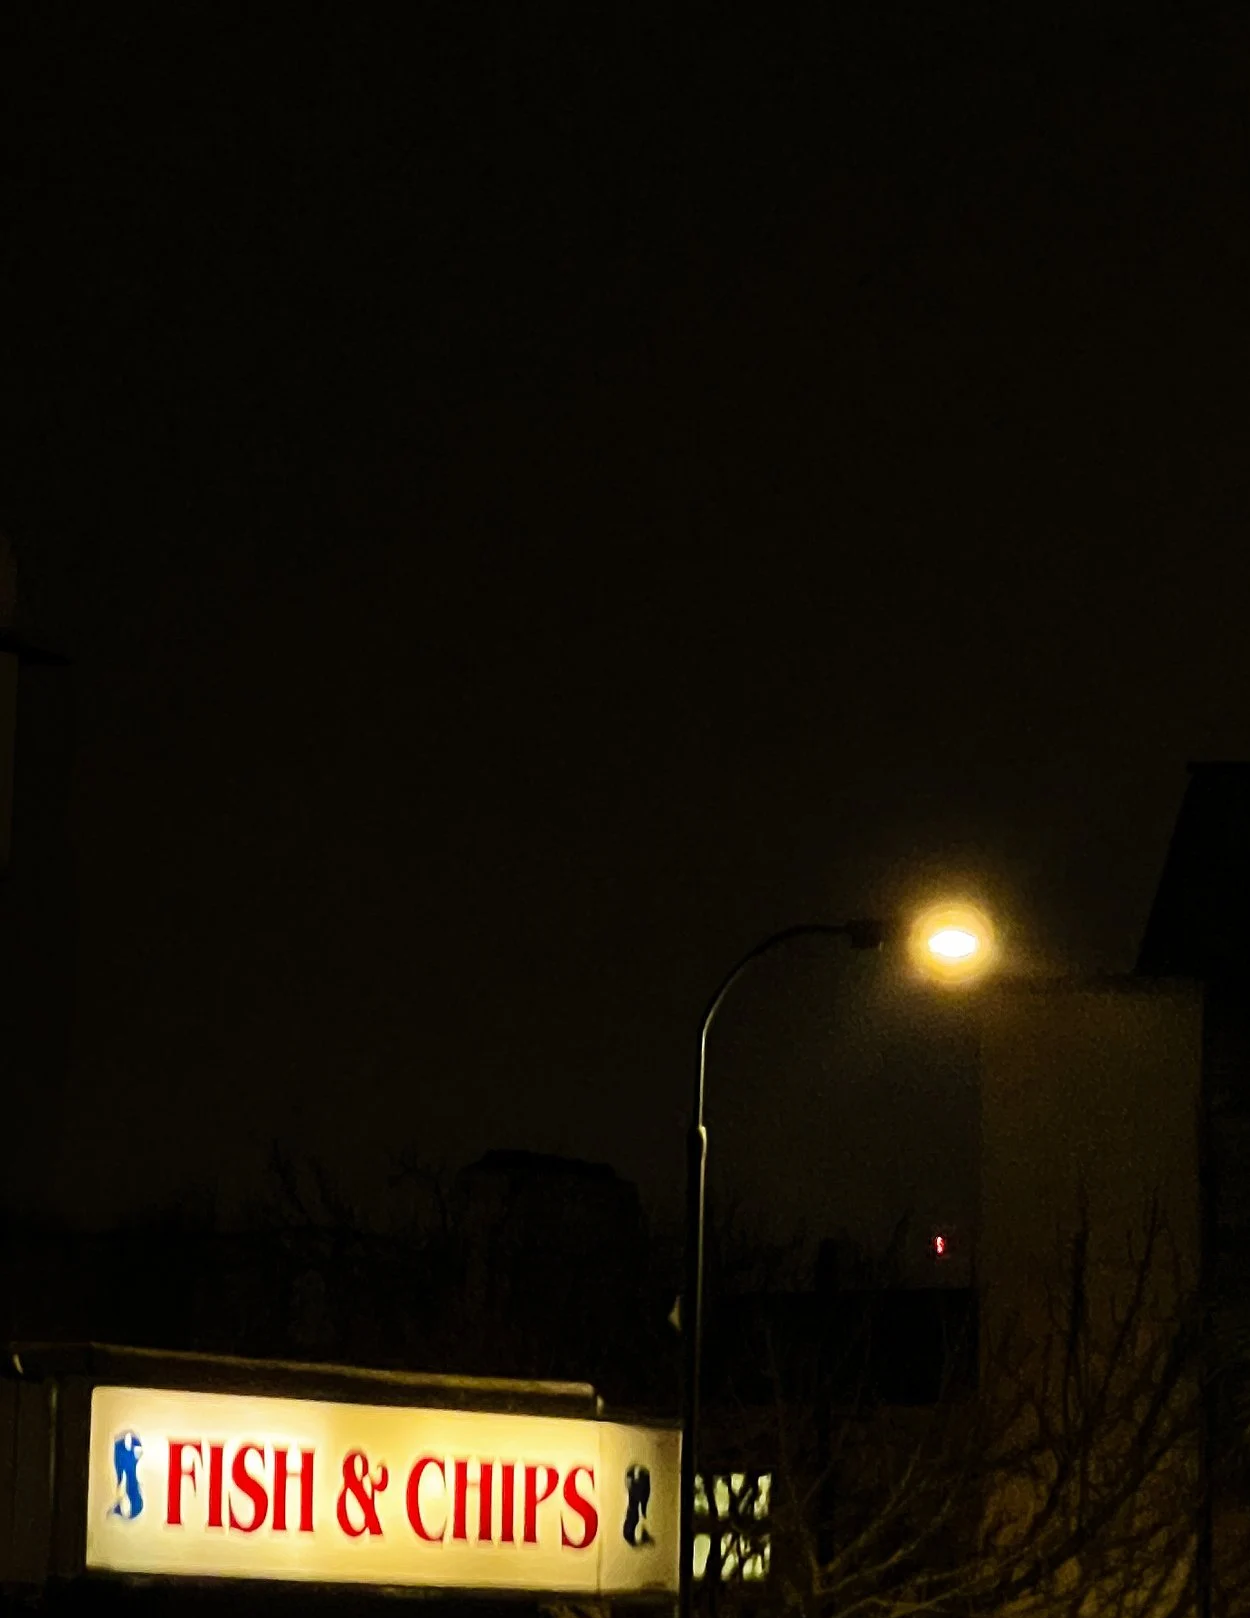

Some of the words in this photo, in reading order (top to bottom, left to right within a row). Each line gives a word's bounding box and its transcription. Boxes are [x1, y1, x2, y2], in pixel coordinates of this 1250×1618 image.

[167, 1442, 314, 1533] FISH
[337, 1451, 388, 1538] &
[406, 1456, 598, 1549] CHIPS
